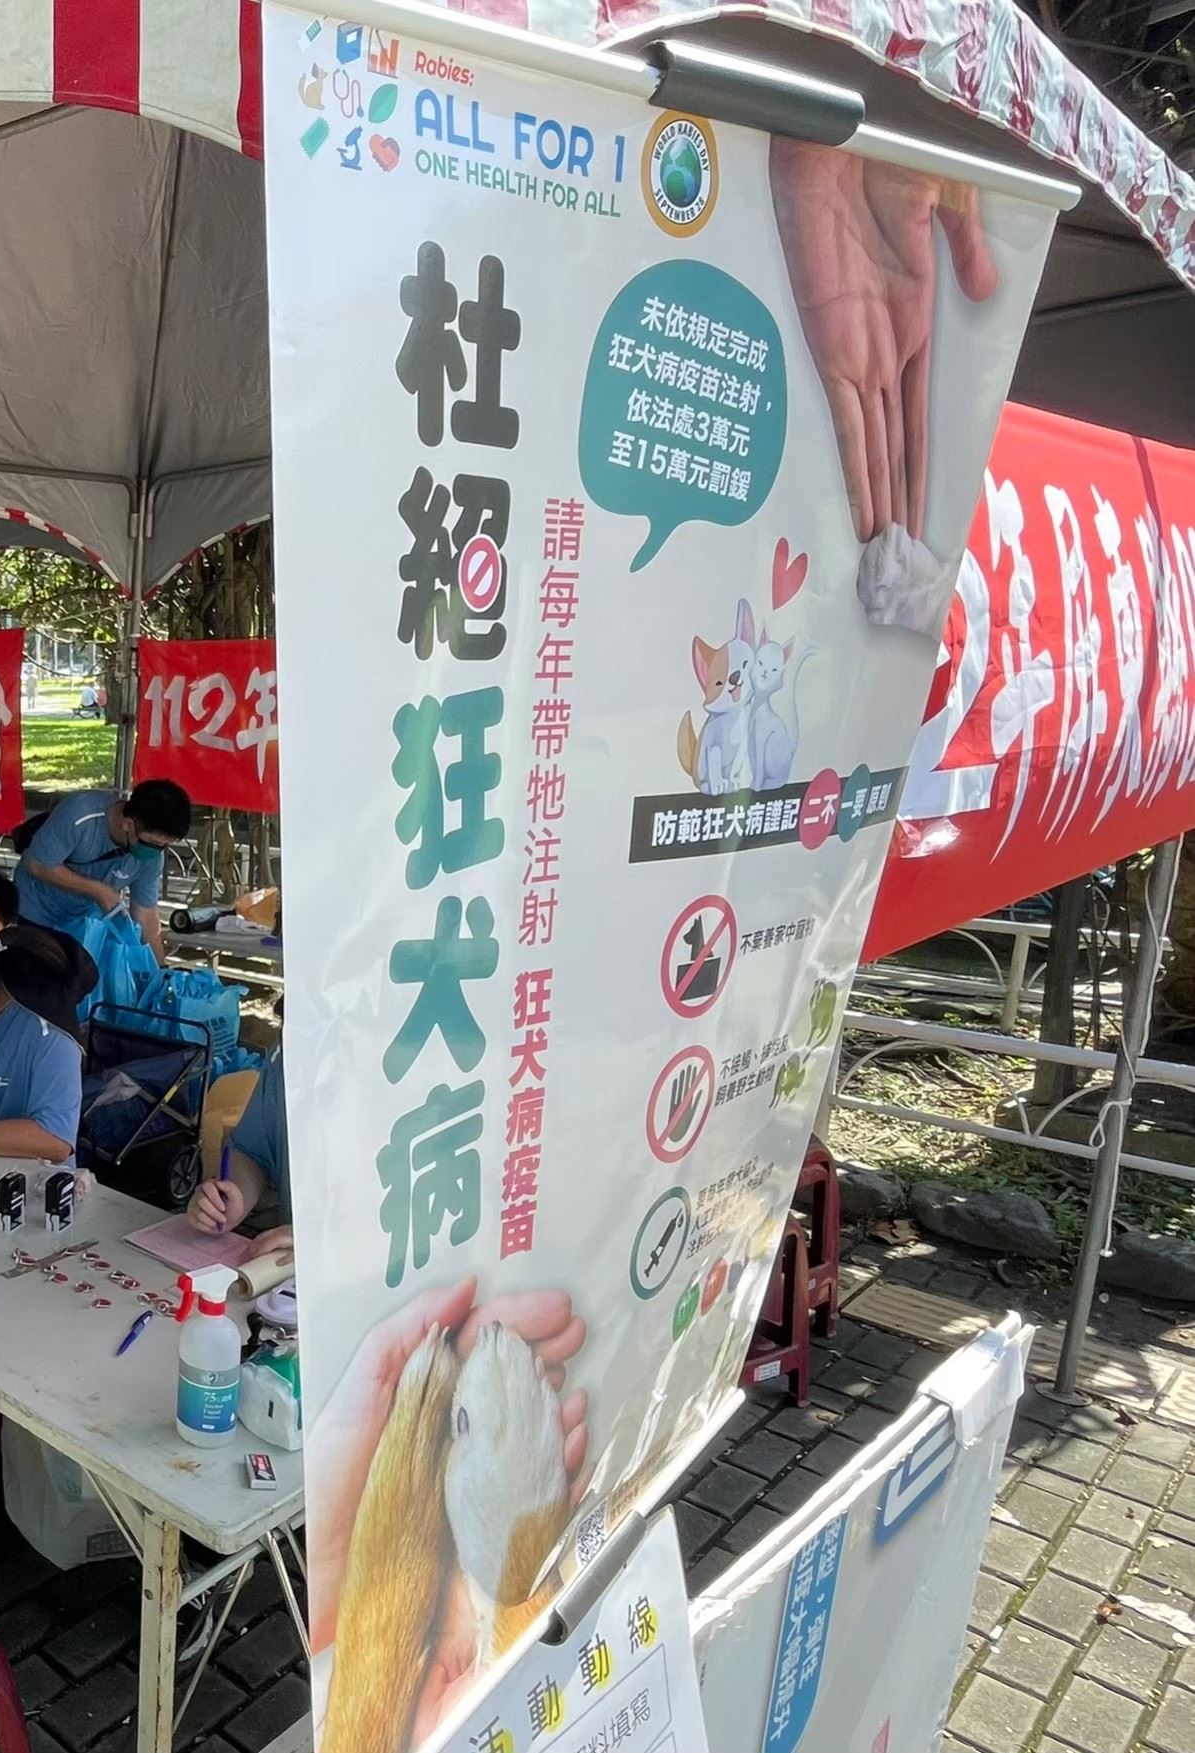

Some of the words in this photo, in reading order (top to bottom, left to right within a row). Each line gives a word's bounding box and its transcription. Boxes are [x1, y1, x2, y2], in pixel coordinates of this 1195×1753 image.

[414, 51, 475, 88] Rabies:
[414, 89, 494, 154] ALL
[514, 114, 595, 178] FOR
[615, 135, 625, 183] 1
[653, 125, 676, 160] WORLD
[677, 123, 704, 149] RABIES
[699, 148, 709, 172] DAY
[414, 149, 460, 183] ONE
[465, 161, 538, 201] HEALTH
[542, 180, 579, 210] FOR
[584, 190, 622, 218] ALL
[655, 187, 696, 222] SEPTEMBER
[641, 296, 768, 374] 未依規定完成
[627, 389, 751, 457] 依法處3萬元
[608, 431, 751, 502] 至15萬元罰鍰
[144, 666, 278, 784] 112年
[518, 497, 585, 947] 請每年帶牠注射
[500, 967, 554, 1261] 狂犬病疫苗
[572, 1688, 651, 1753] 料填寫
